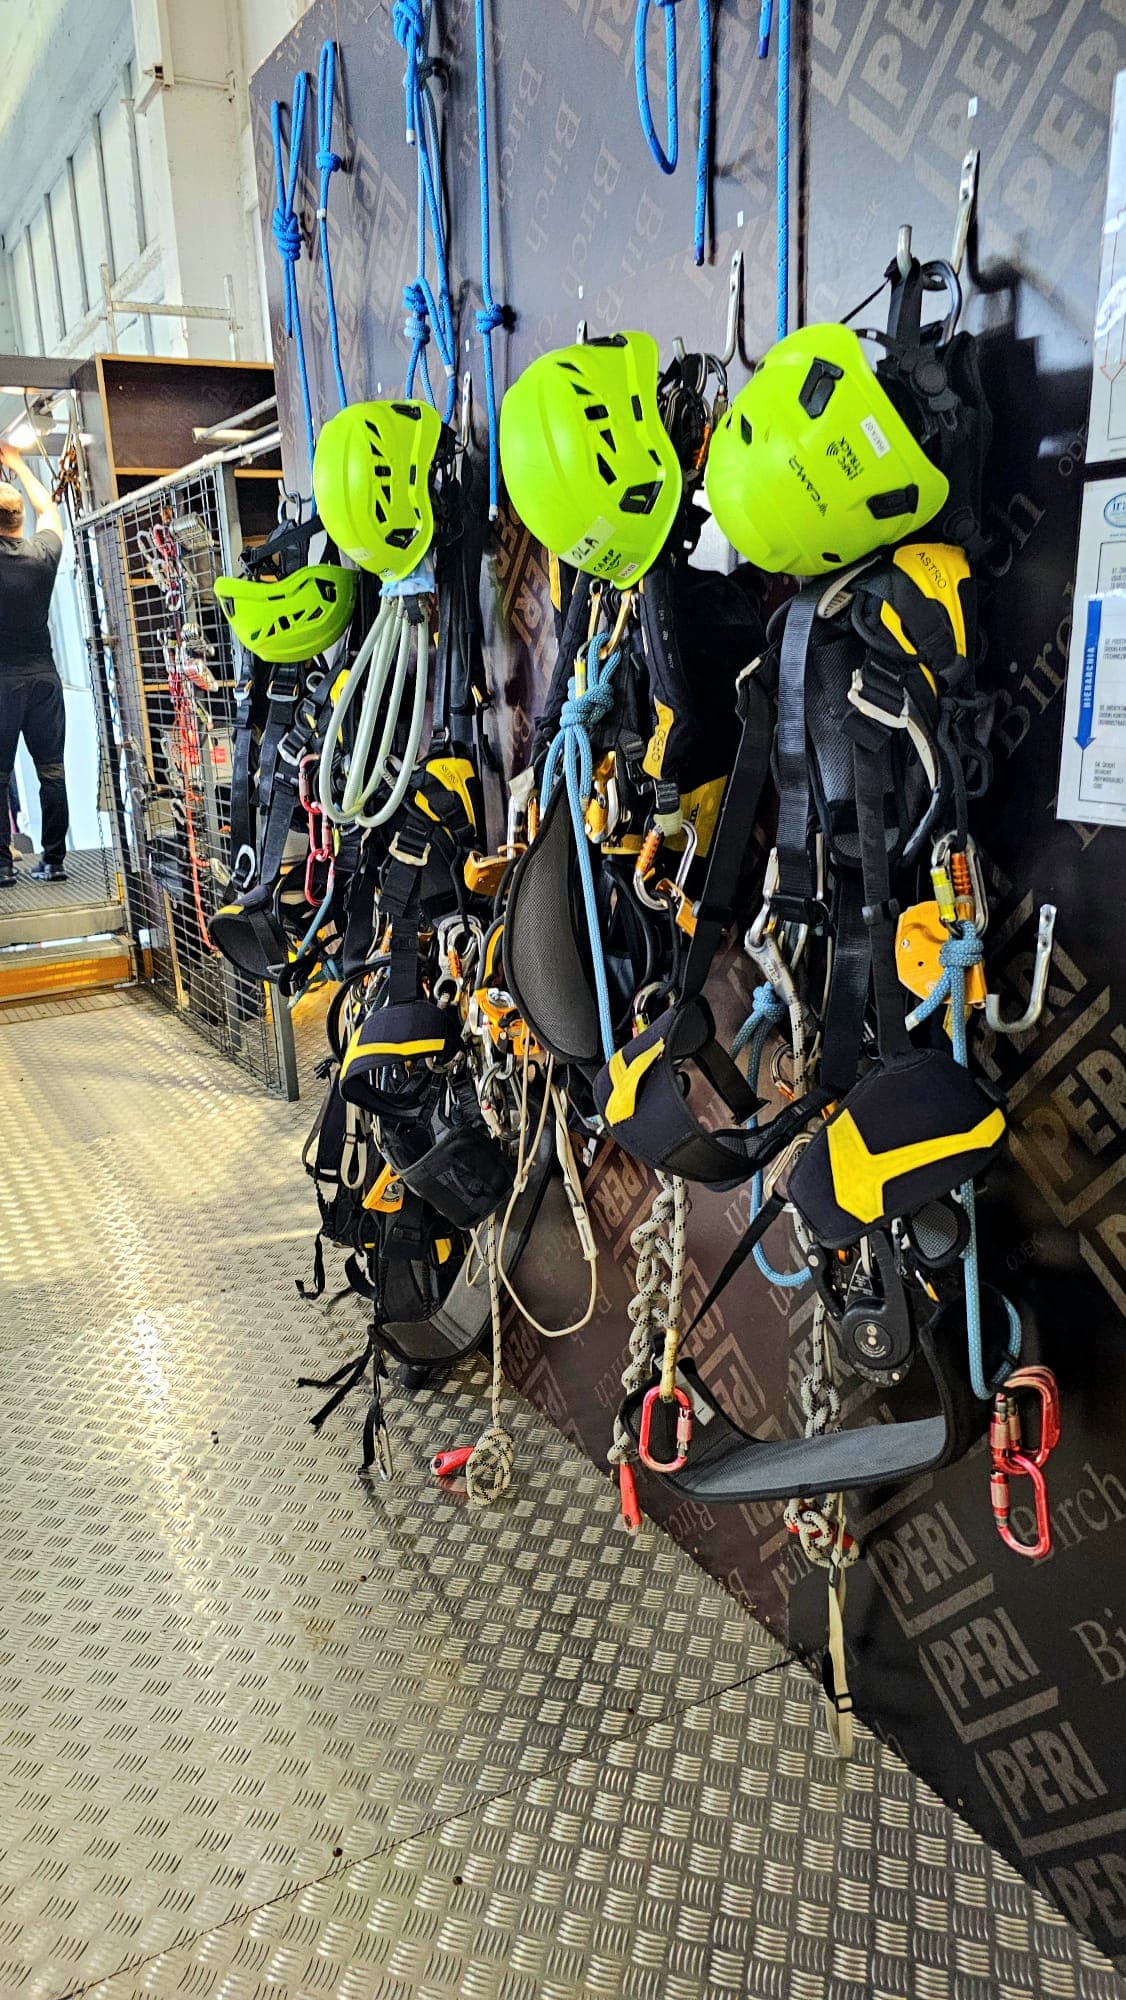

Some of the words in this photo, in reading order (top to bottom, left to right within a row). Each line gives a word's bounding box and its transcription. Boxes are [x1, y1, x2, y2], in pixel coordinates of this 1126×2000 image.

[916, 551, 947, 589] ASTRO
[1022, 1024, 1126, 1182] PER
[590, 1149, 643, 1240] PERI
[877, 1500, 979, 1606] PERI
[931, 1606, 1040, 1710] PERI
[991, 1720, 1108, 1824] PERI
